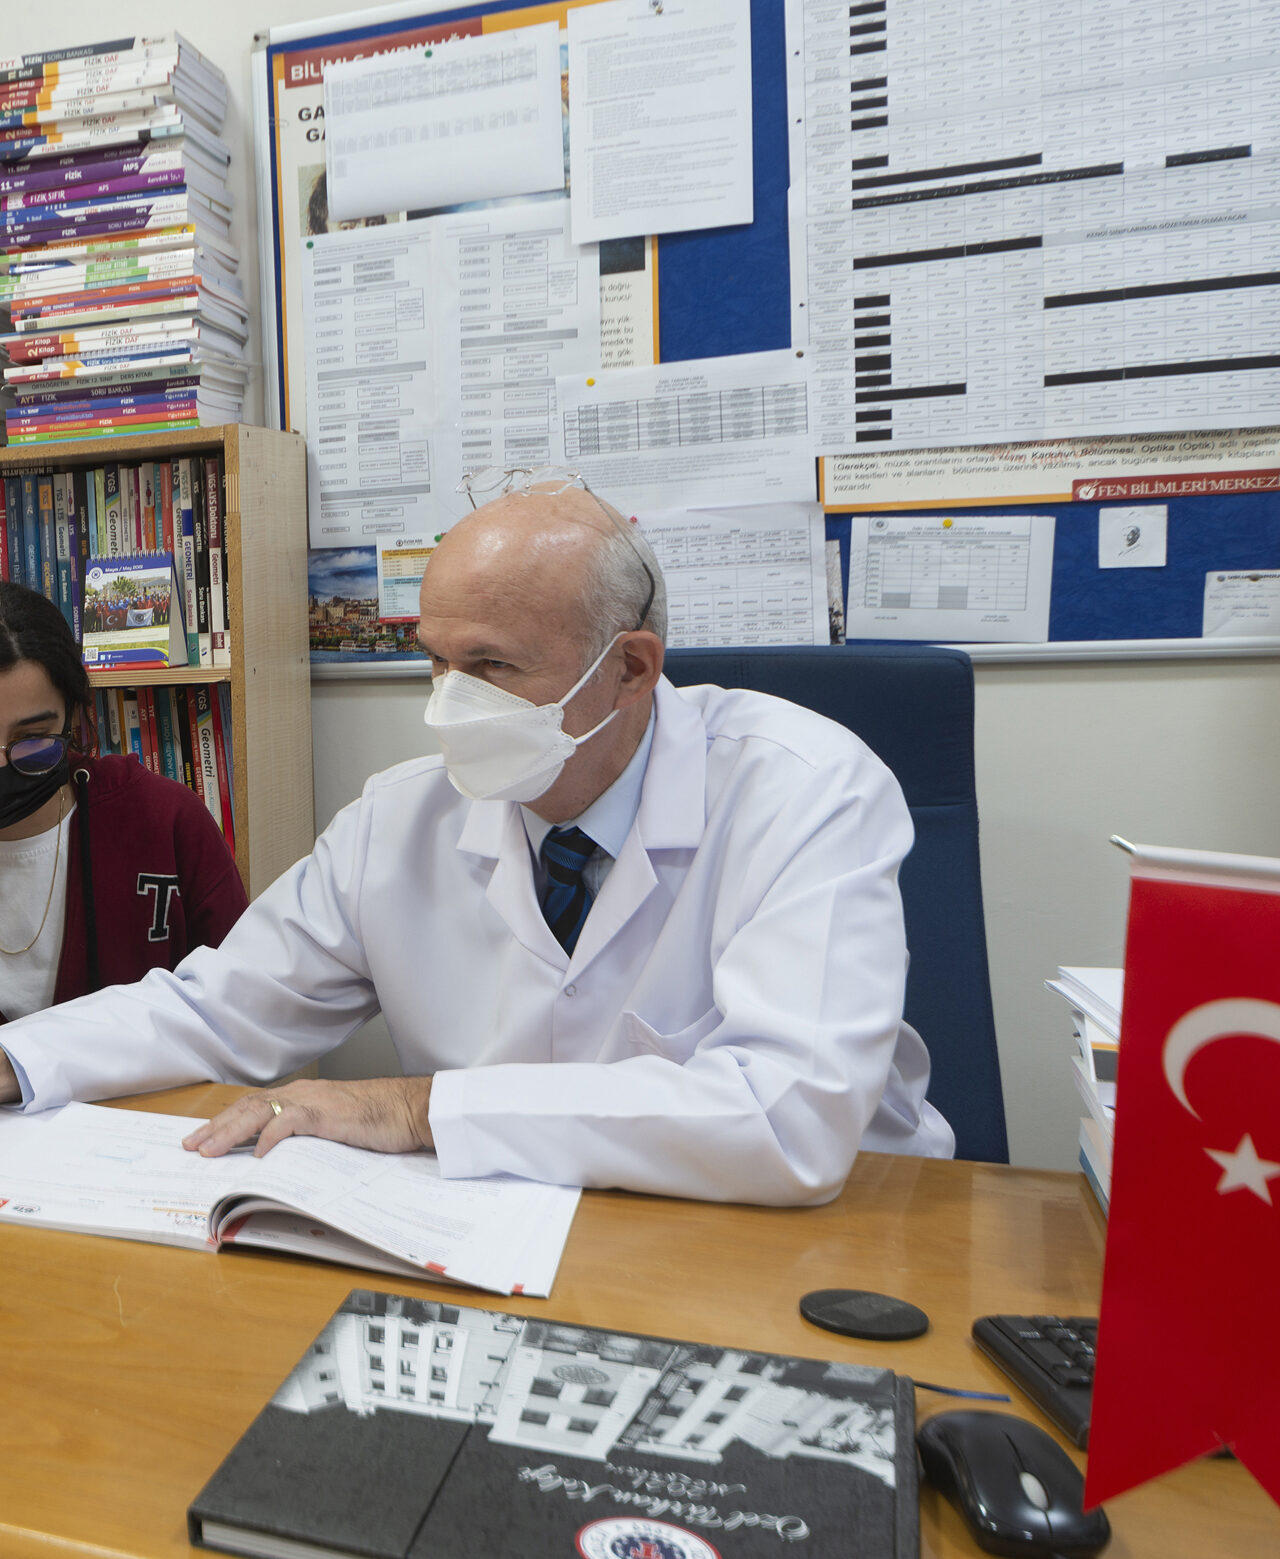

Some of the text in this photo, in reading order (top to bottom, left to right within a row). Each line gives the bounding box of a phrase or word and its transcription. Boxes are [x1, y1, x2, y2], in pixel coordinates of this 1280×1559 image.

[0, 61, 15, 69] TYT
[104, 55, 119, 64] DAF
[96, 85, 110, 93] DAF
[125, 336, 138, 344] DAF
[91, 388, 106, 396] SORU
[108, 385, 131, 394] BANKASI
[1130, 431, 1186, 442] Dedomena
[885, 460, 910, 468] müzik
[914, 457, 962, 467] orantılarını
[966, 455, 995, 464] ortaya
[1141, 443, 1175, 453] Optika
[1179, 441, 1215, 451] (Optik)
[1220, 440, 1237, 448] adlı
[833, 473, 851, 481] koni
[855, 471, 887, 479] kesitleri
[907, 468, 945, 478] alanların
[953, 465, 999, 474] bölünmesi
[1004, 463, 1038, 472] üzerine
[1088, 457, 1117, 467] ancak
[1122, 455, 1158, 466] bugüne
[1228, 448, 1275, 458] kitapların
[107, 472, 115, 492] YGS
[1099, 484, 1127, 497] FEN
[1131, 477, 1207, 495] BİLİMLERİ
[209, 506, 218, 539] Doktoru
[212, 553, 220, 585] Geometri
[197, 689, 215, 777] YGS Geometri
[137, 873, 180, 941] T
